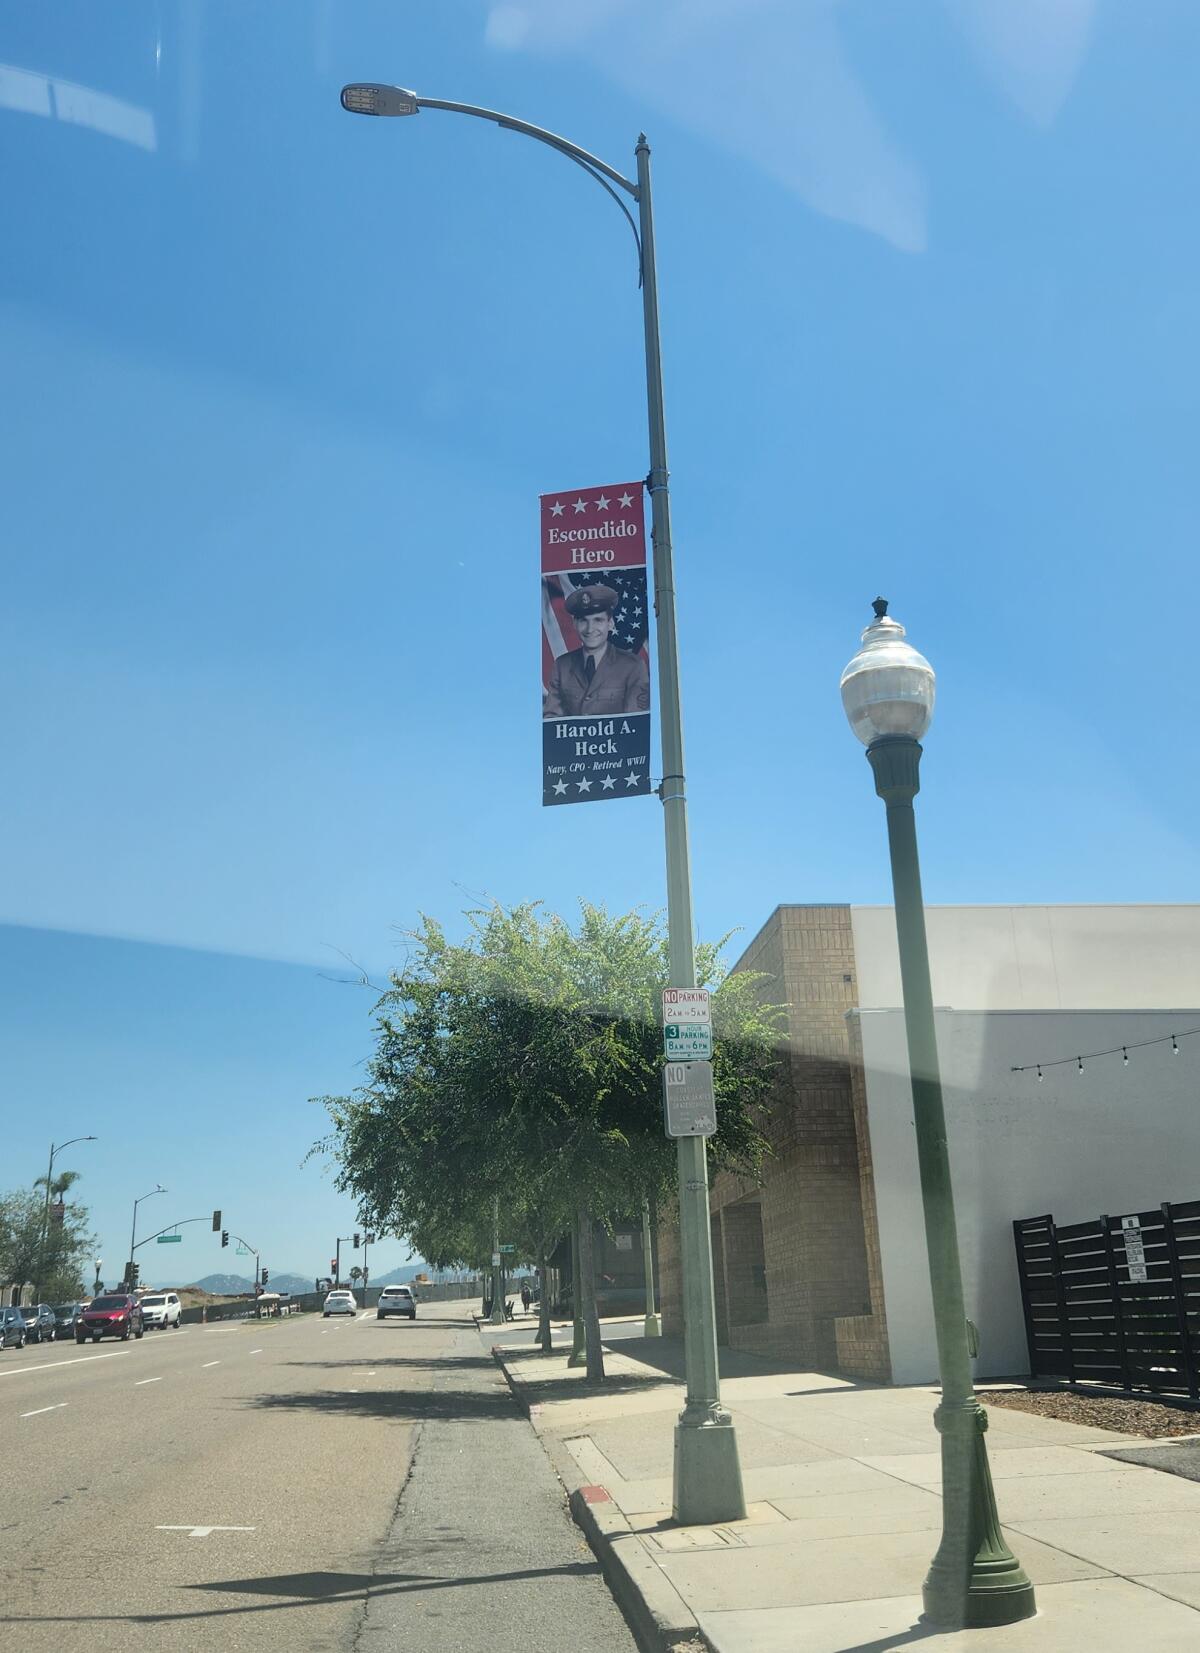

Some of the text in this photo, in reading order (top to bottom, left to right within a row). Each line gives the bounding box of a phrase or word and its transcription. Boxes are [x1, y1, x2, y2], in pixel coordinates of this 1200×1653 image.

[548, 520, 637, 544] Escondido
[570, 547, 615, 564] Hero
[555, 720, 636, 739] Harold A.
[575, 739, 618, 756] Heck
[569, 762, 585, 772] CPO
[592, 758, 623, 771] Retired
[626, 755, 646, 767] WWII
[665, 991, 707, 1002] NO PARKING
[670, 1026, 709, 1040] 3 PARKING
[668, 1067, 683, 1083] NO
